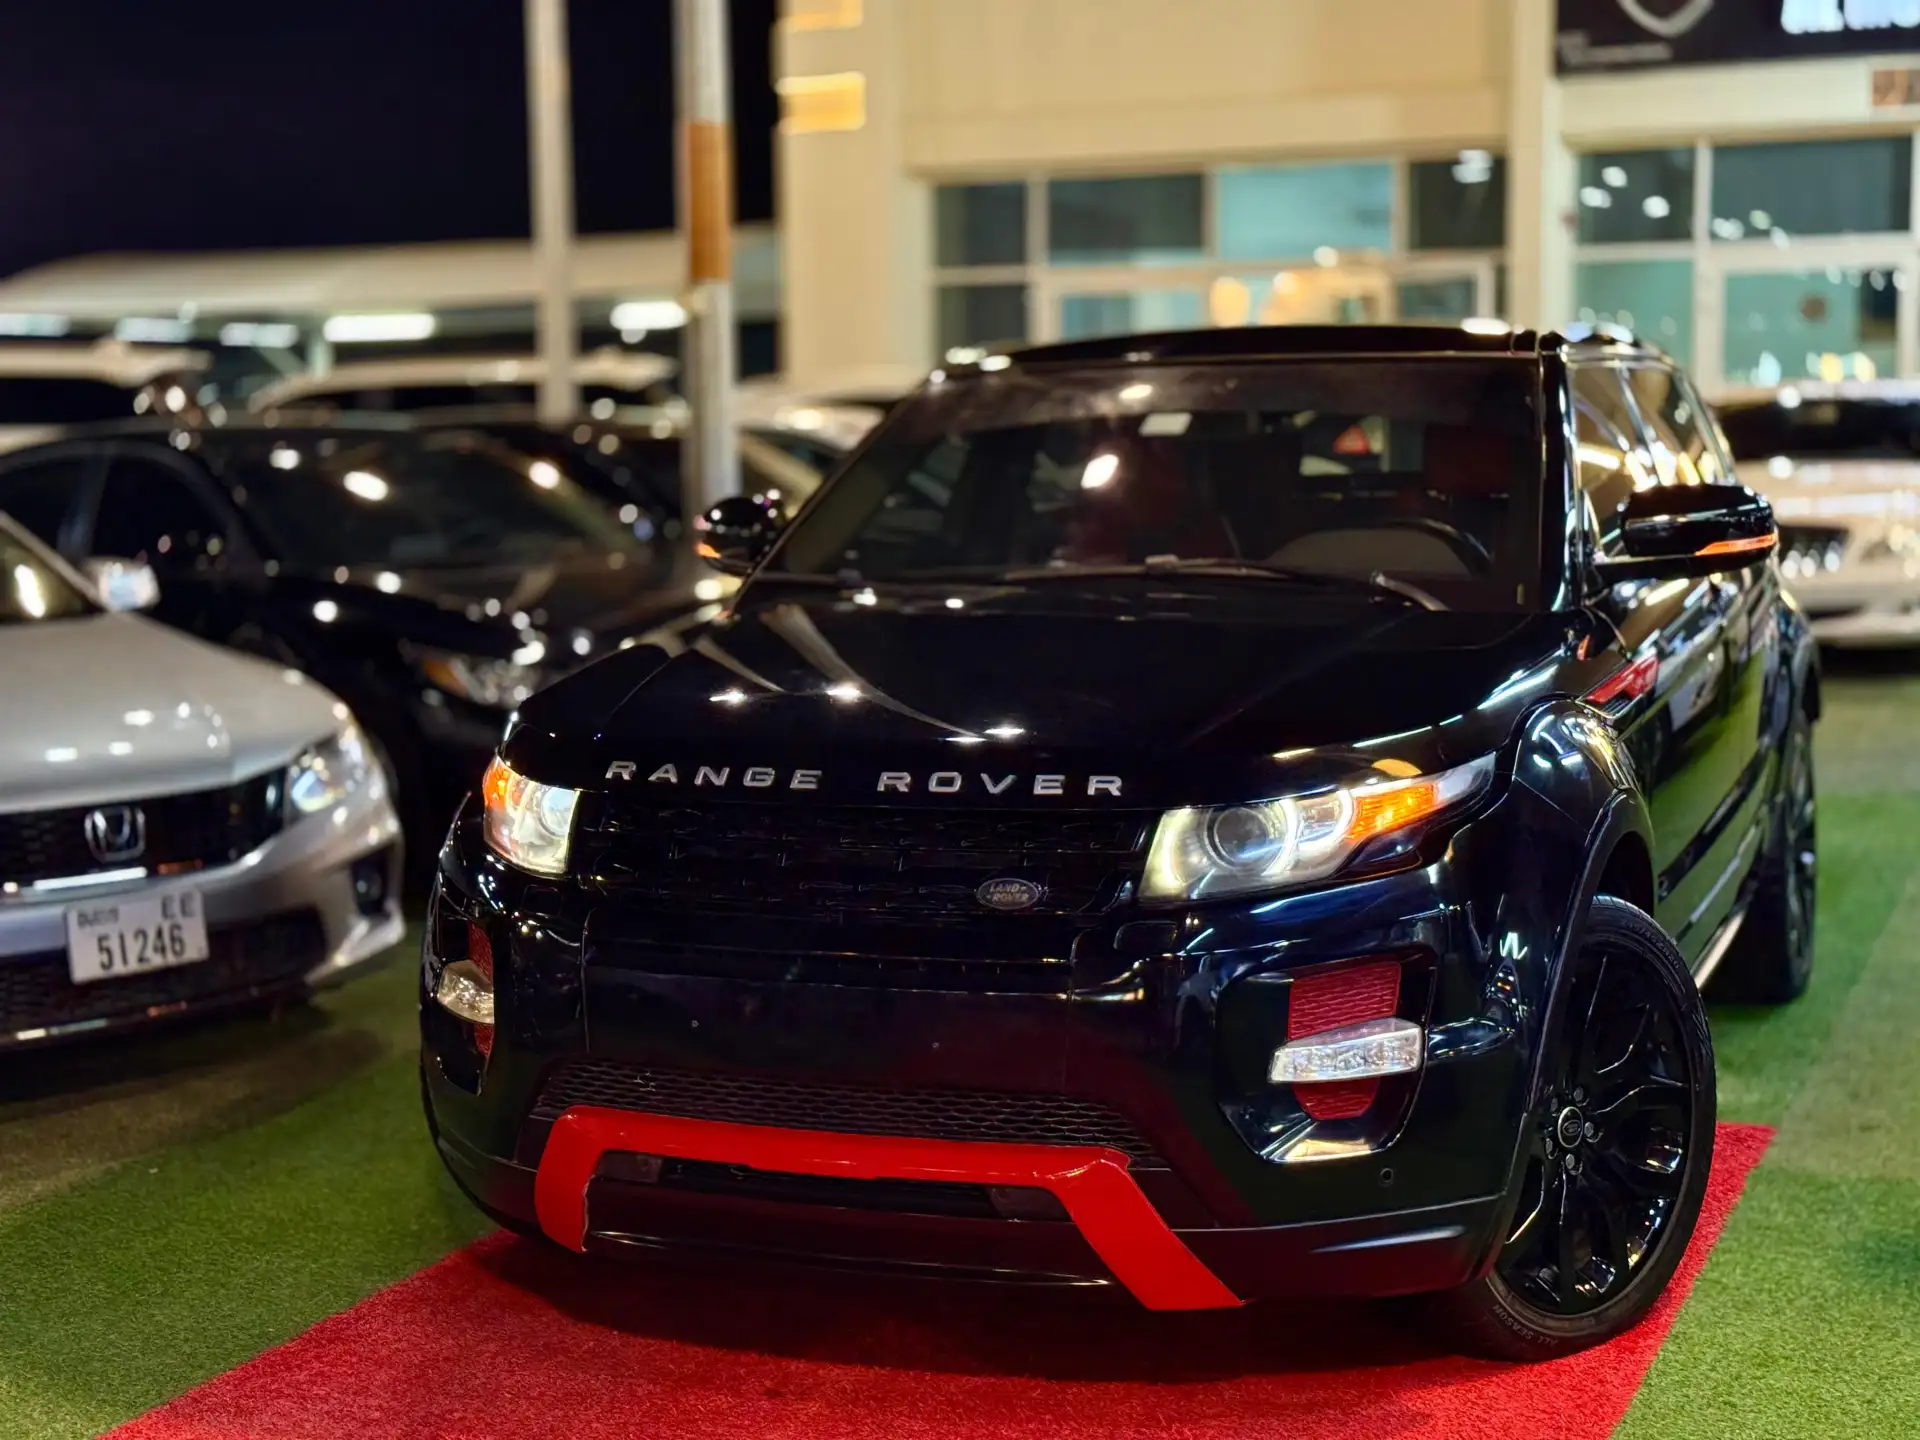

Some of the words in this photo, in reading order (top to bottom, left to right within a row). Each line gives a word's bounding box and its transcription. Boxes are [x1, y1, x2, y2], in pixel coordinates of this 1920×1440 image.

[604, 760, 823, 790] RANGE
[876, 771, 1124, 797] ROVER
[989, 883, 1020, 893] LAND
[991, 892, 1030, 903] ROVER
[97, 923, 186, 971] 51246
[1491, 1303, 1535, 1340] SEASON
